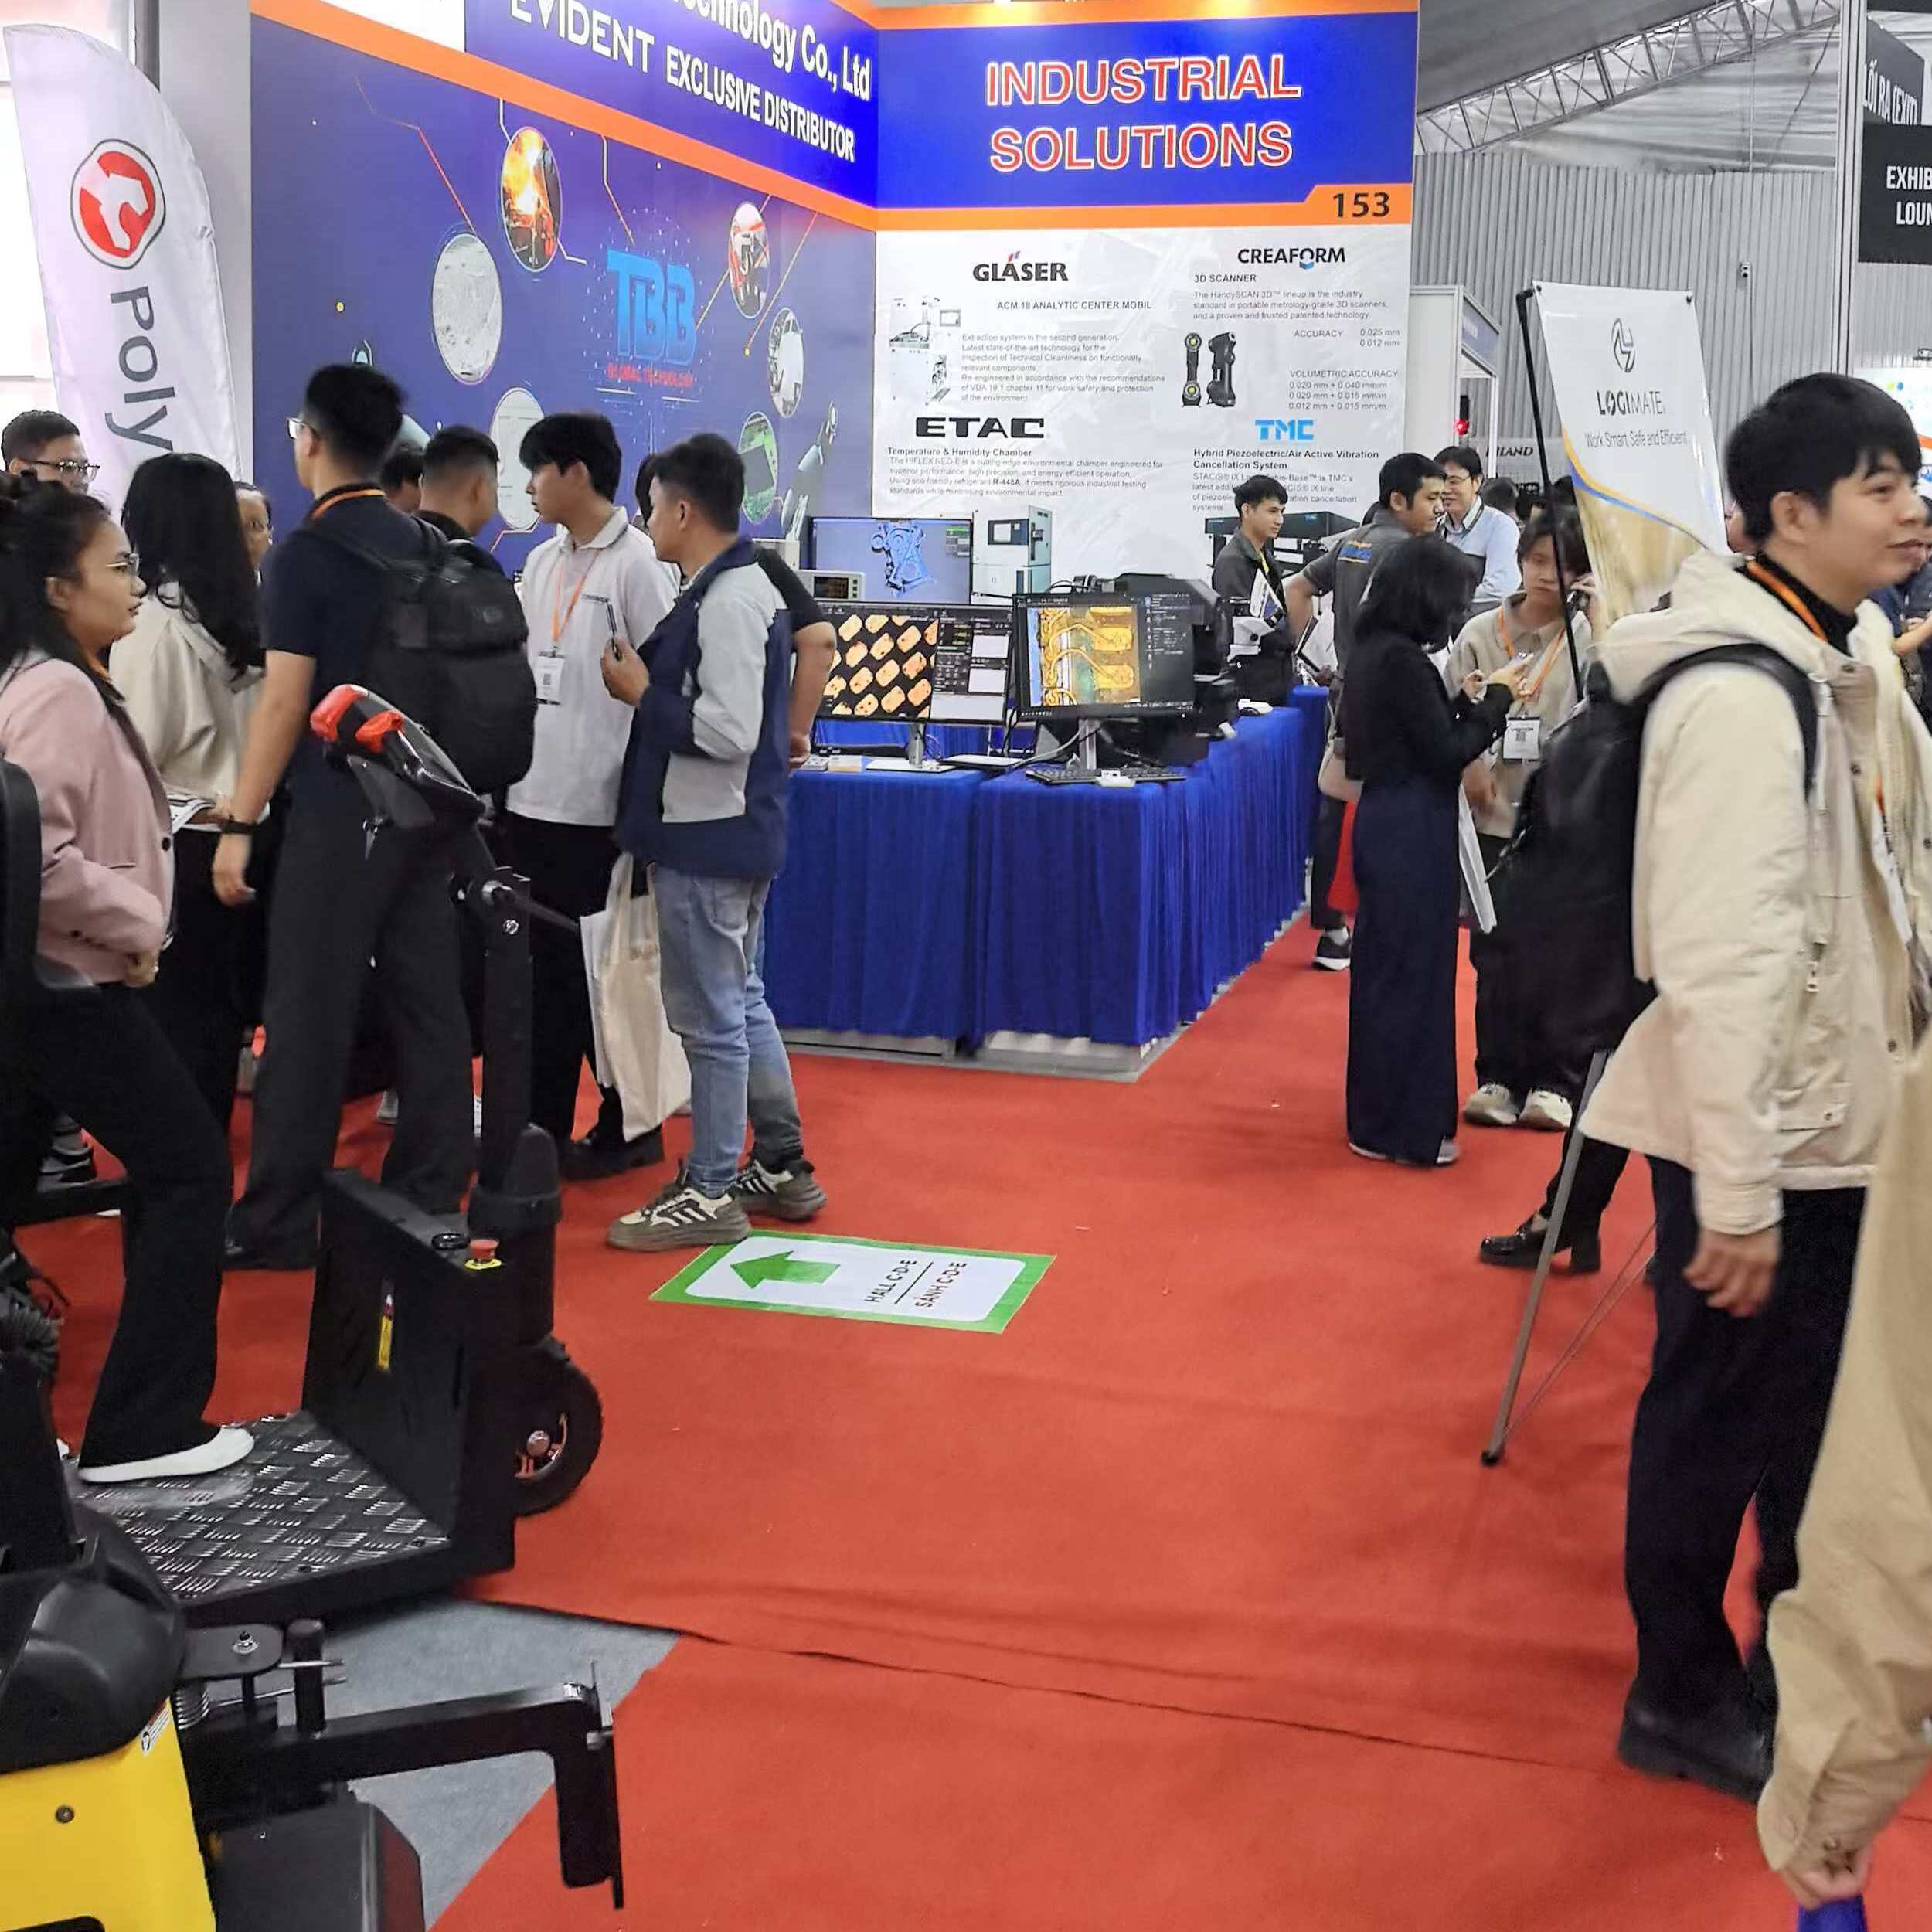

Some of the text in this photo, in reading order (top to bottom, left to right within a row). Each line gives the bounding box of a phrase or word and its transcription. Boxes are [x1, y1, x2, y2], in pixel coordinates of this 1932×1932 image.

[801, 24, 837, 93] Co.,
[842, 46, 872, 101] Ltd
[985, 54, 1302, 107] INDUSTRIAL
[666, 45, 760, 121] EXCLUSIVE
[764, 90, 855, 163] DISTRIBUTOR
[1878, 75, 1890, 122] RA
[990, 121, 1293, 172] SOLUTIONS
[1332, 192, 1390, 219] 153
[1237, 247, 1346, 270] CREAFORM
[1194, 274, 1257, 282] 3D SCANNER
[606, 248, 697, 366] TBB
[1081, 301, 1120, 309] CENTER
[1122, 301, 1152, 309] MOBIL
[1000, 334, 1026, 342] system
[105, 287, 175, 451] Poly
[916, 417, 1044, 438] ETAC
[1254, 419, 1315, 441] TMC
[888, 447, 940, 456] Temperature
[952, 448, 990, 457] Humidity
[1194, 449, 1379, 458] Hybrid Piezoelectric/Air Active Vibration
[1110, 460, 1151, 468] engineered
[1193, 461, 1287, 471] Cancellation System
[1122, 480, 1146, 488] testing
[864, 1283, 896, 1302] HALL
